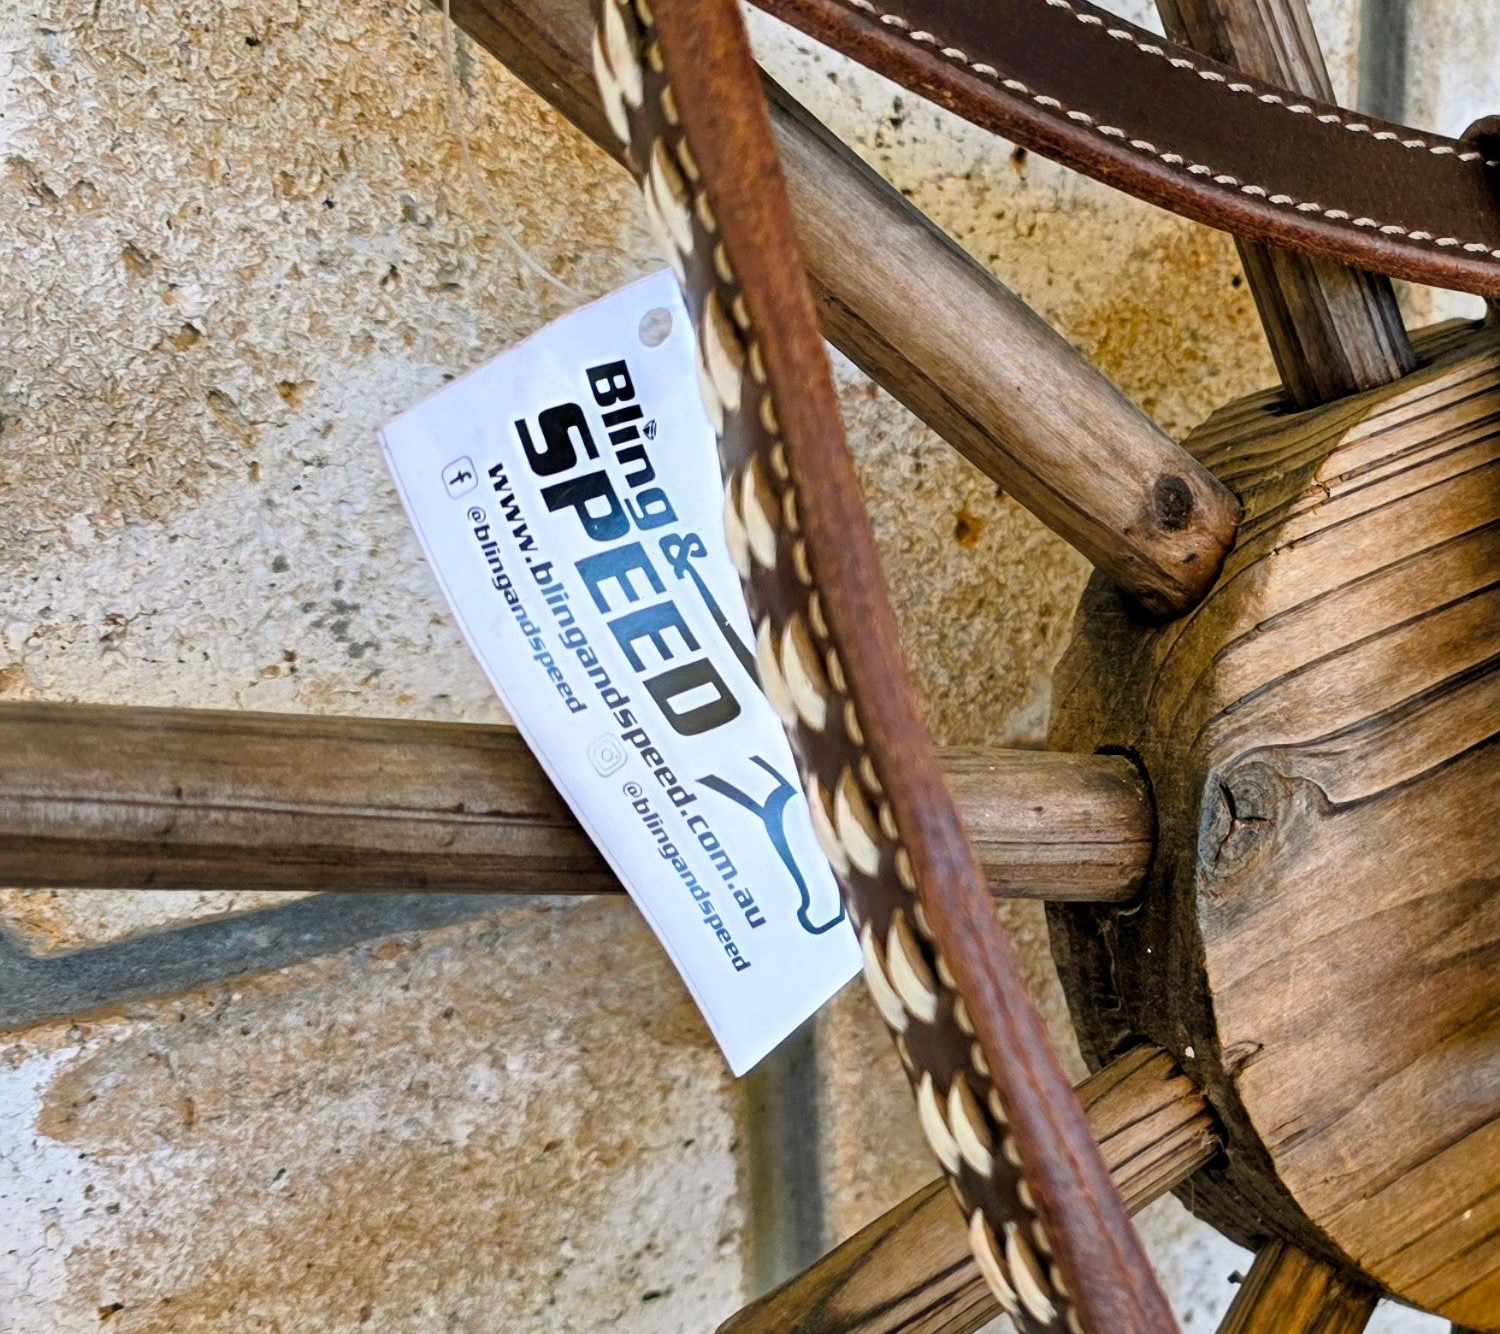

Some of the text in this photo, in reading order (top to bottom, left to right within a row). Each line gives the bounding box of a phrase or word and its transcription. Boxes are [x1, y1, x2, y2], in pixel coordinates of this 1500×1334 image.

[514, 401, 742, 737] SPEED
[585, 359, 708, 580] Bling &
[466, 505, 589, 715] @blingandspeed
[487, 462, 767, 930] www.blingandspeed.com.au
[622, 781, 752, 973] @blingandspeed
